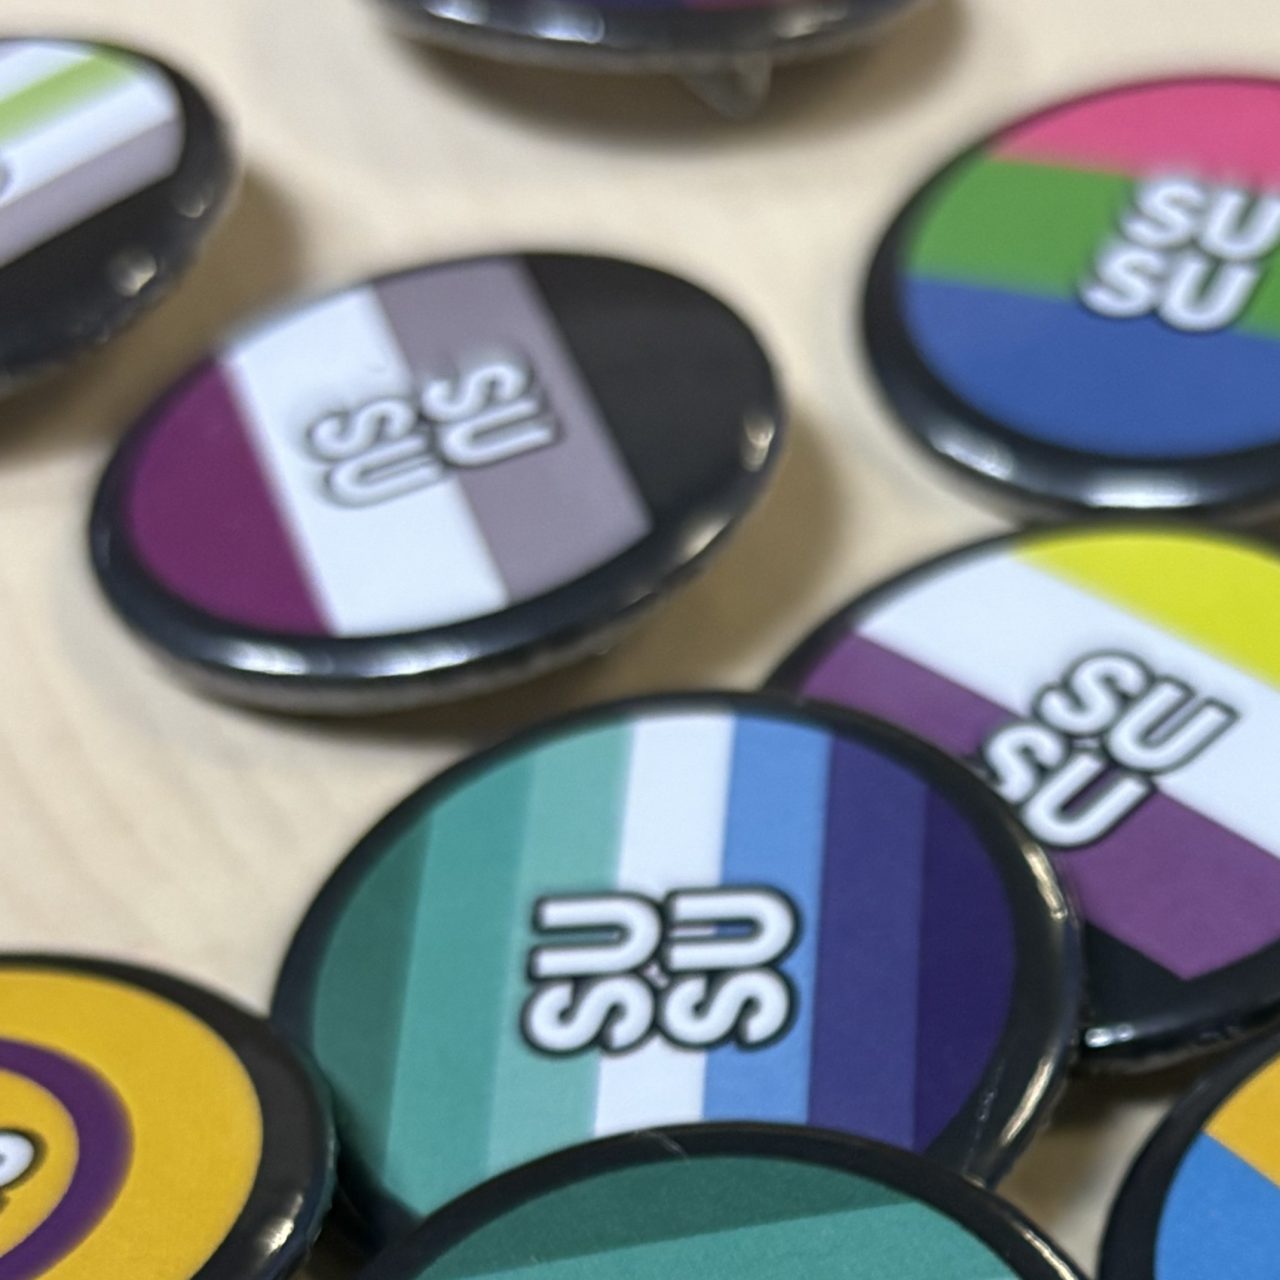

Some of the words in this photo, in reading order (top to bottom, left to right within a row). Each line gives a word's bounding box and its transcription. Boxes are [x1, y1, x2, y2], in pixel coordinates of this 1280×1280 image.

[1082, 243, 1258, 333] SU
[310, 397, 442, 502] SU
[420, 361, 557, 466] SU
[1036, 652, 1233, 771] SU
[526, 896, 663, 1052] SU
[662, 887, 796, 1048] SU
